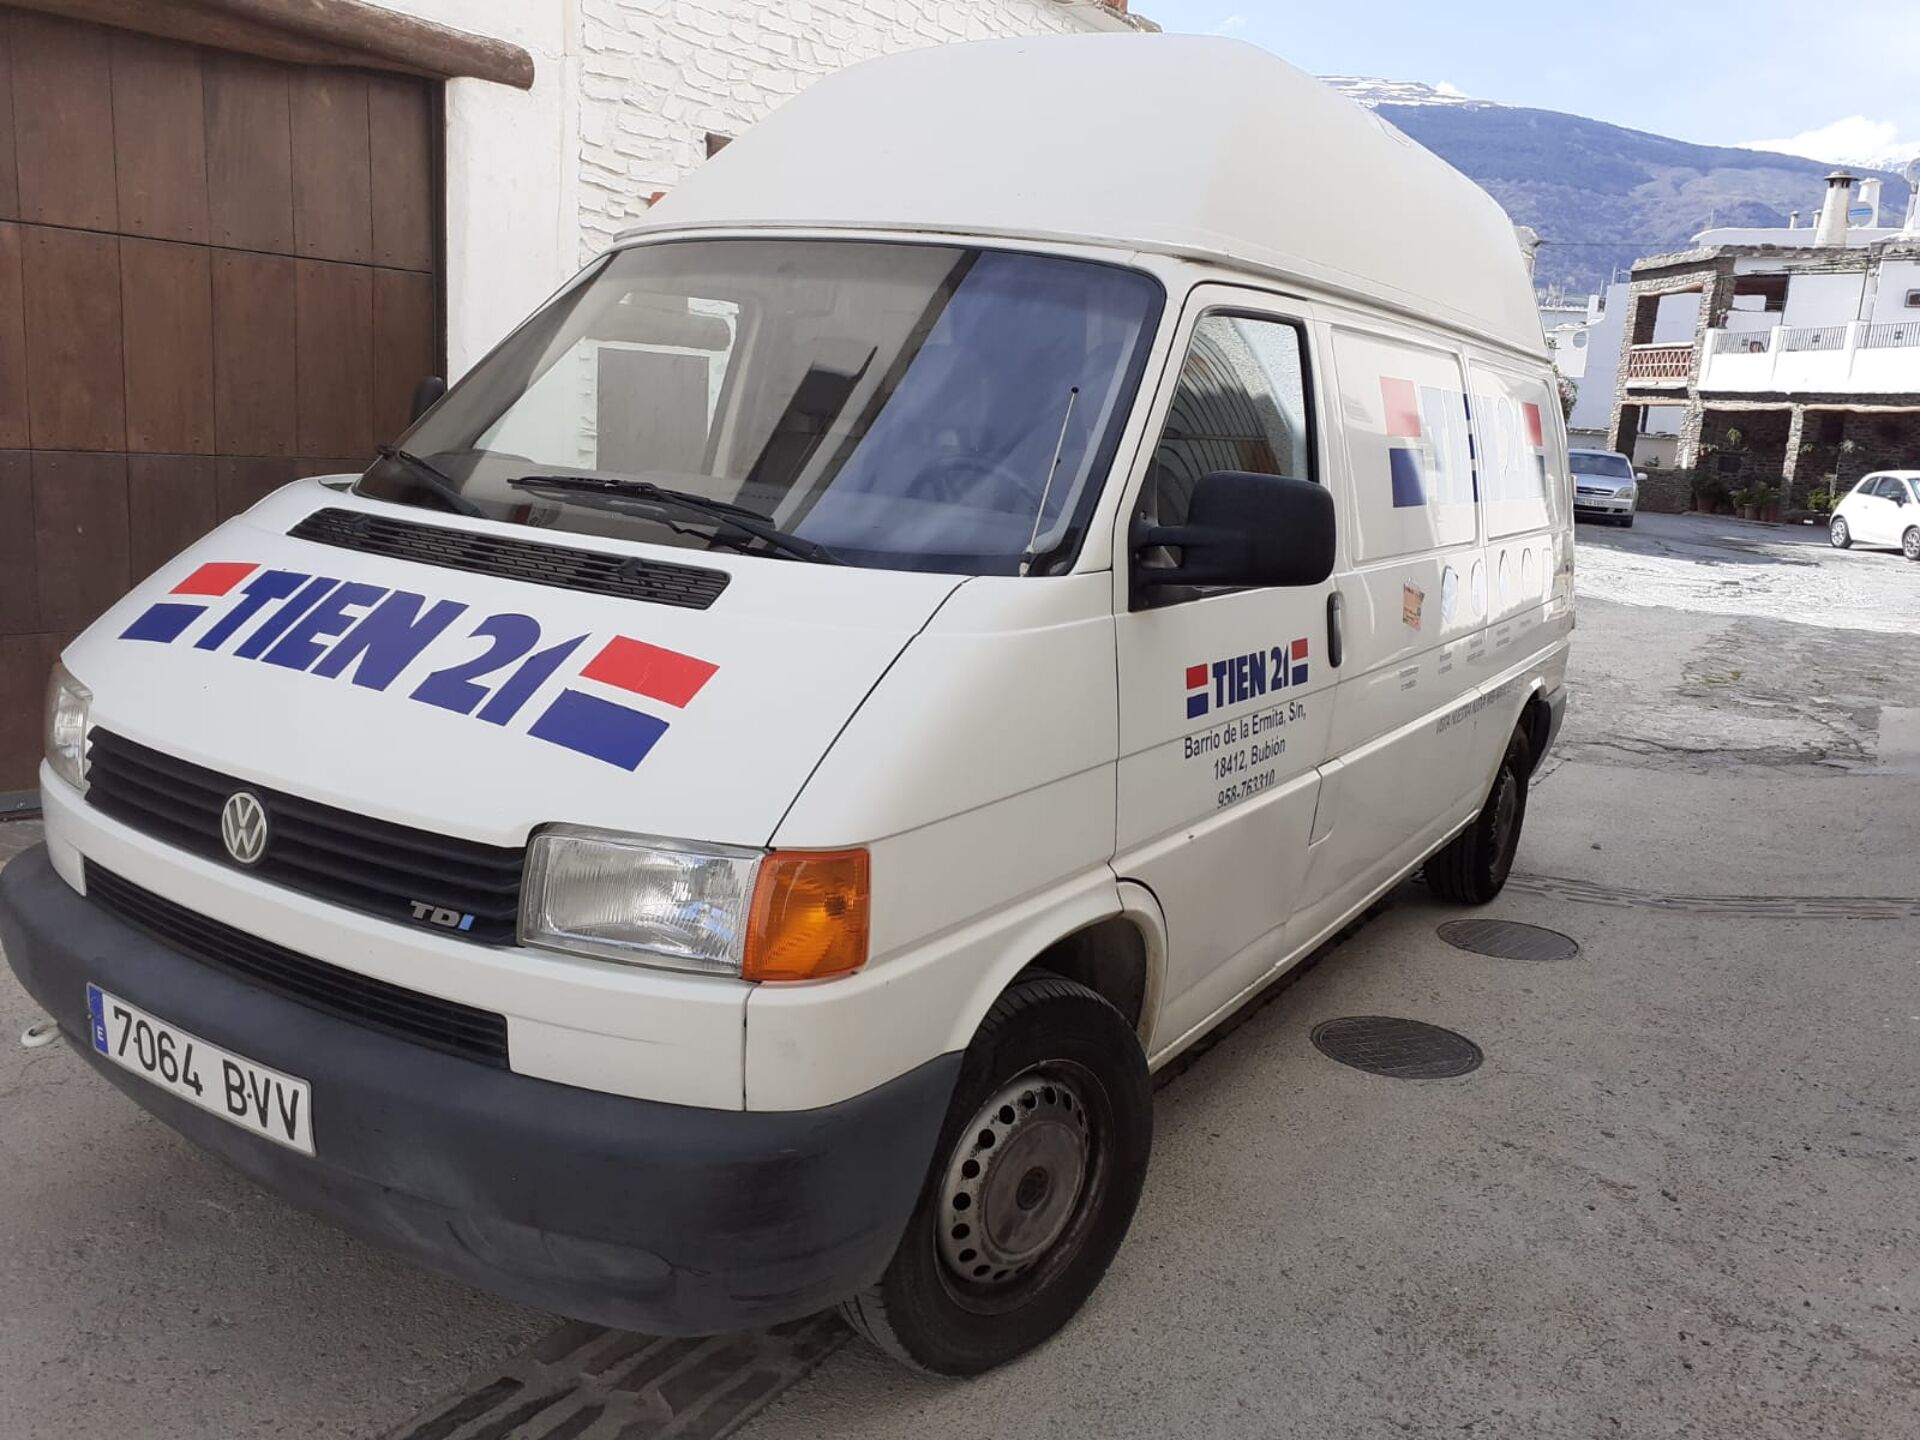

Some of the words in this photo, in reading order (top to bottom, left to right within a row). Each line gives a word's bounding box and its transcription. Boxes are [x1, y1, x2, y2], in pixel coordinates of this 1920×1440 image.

[194, 569, 470, 692] TIEN
[409, 613, 593, 726] 21
[1212, 651, 1266, 708] TIEN
[1270, 644, 1289, 692] 21
[1184, 731, 1220, 760] Barrio
[1224, 723, 1237, 746] de
[1240, 719, 1249, 739] la
[1214, 750, 1247, 780] 18412,
[1251, 736, 1286, 766] Bubión
[1217, 769, 1276, 810] 958-763310
[410, 900, 475, 931] TDI
[113, 1005, 203, 1097] 7064
[222, 1059, 299, 1141] BVV
